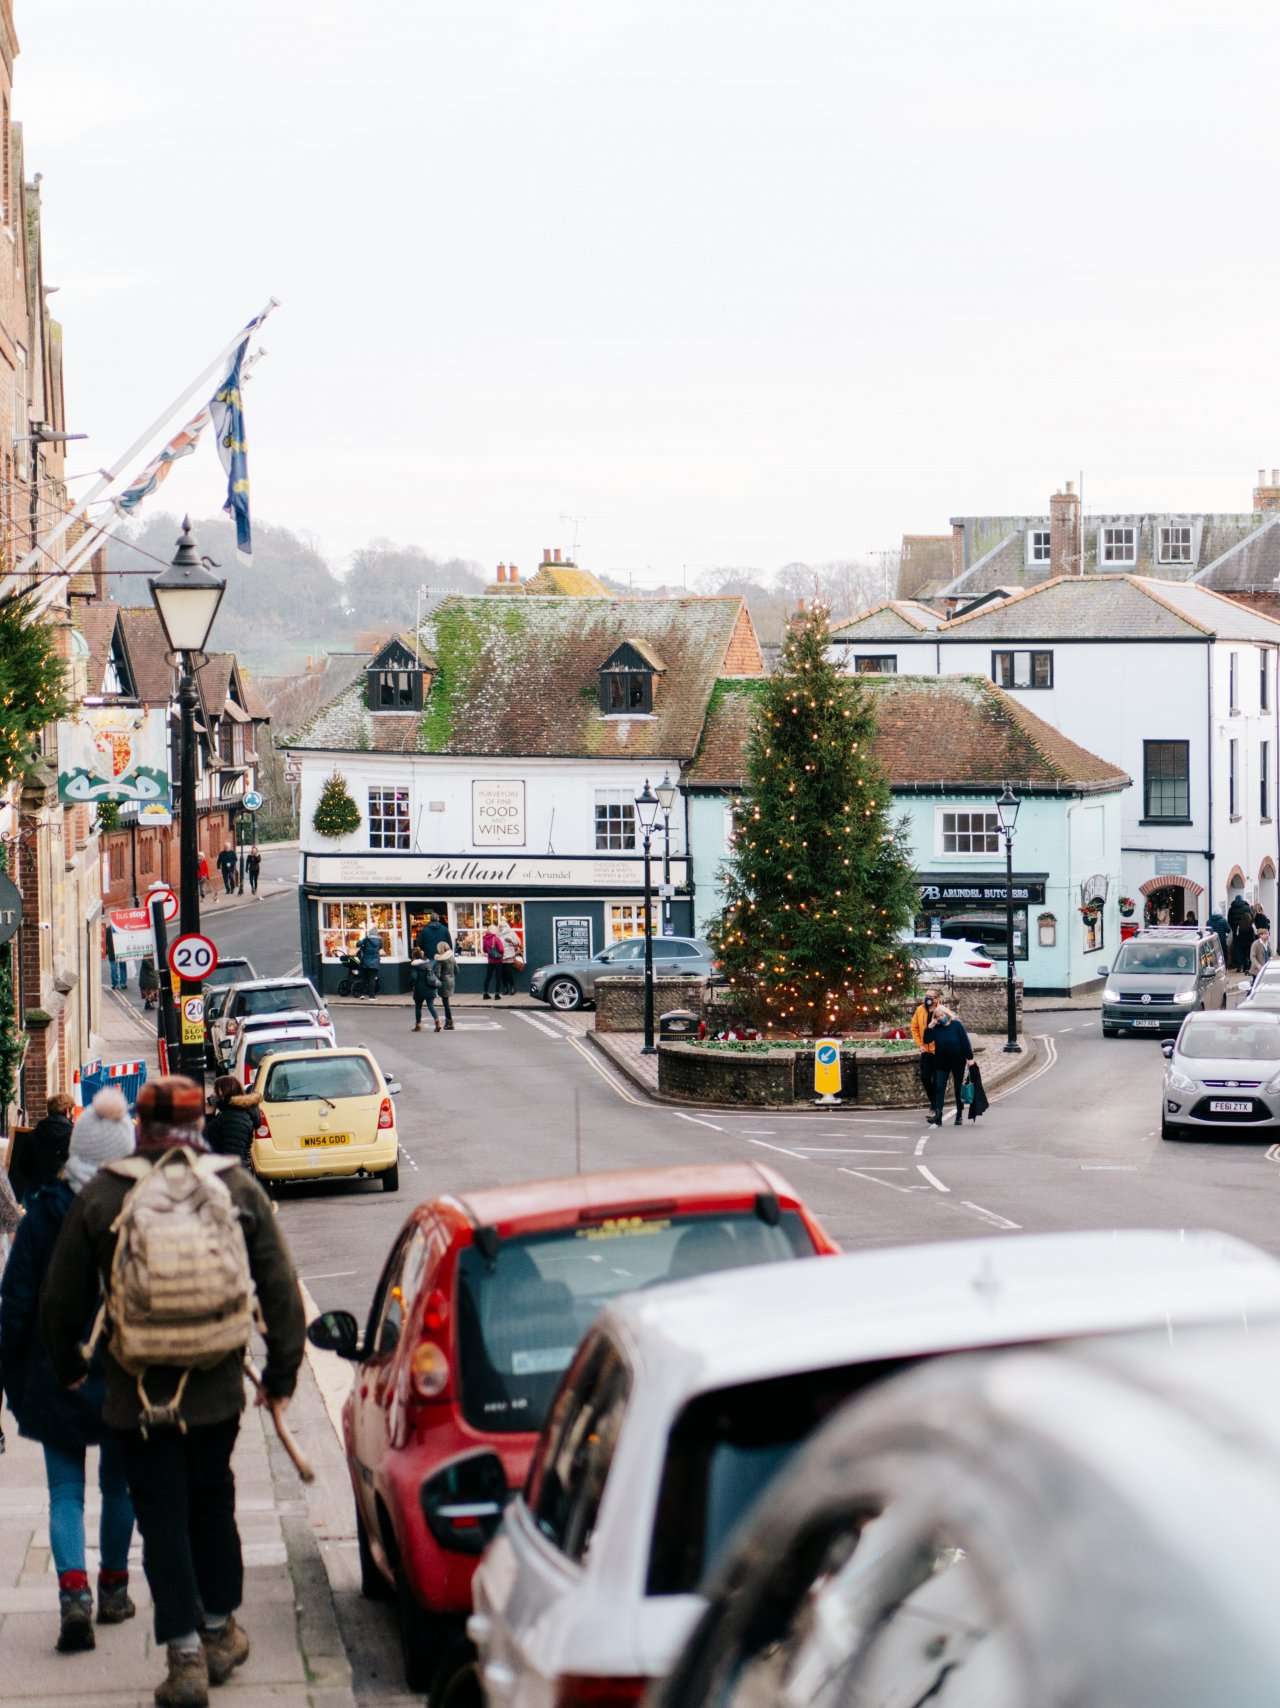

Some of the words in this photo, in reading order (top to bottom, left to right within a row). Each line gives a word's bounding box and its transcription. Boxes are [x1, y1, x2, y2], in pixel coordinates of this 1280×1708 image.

[479, 806, 519, 817] FOOD
[478, 823, 521, 835] WINES
[427, 861, 517, 880] Pallant
[537, 871, 571, 880] Arundel
[942, 888, 982, 898] ARUNDEL
[984, 888, 1029, 898] BUTCERS
[129, 910, 146, 919] stop
[177, 949, 211, 967] 20
[187, 1002, 203, 1016] 20
[1233, 1103, 1248, 1111] ZTX
